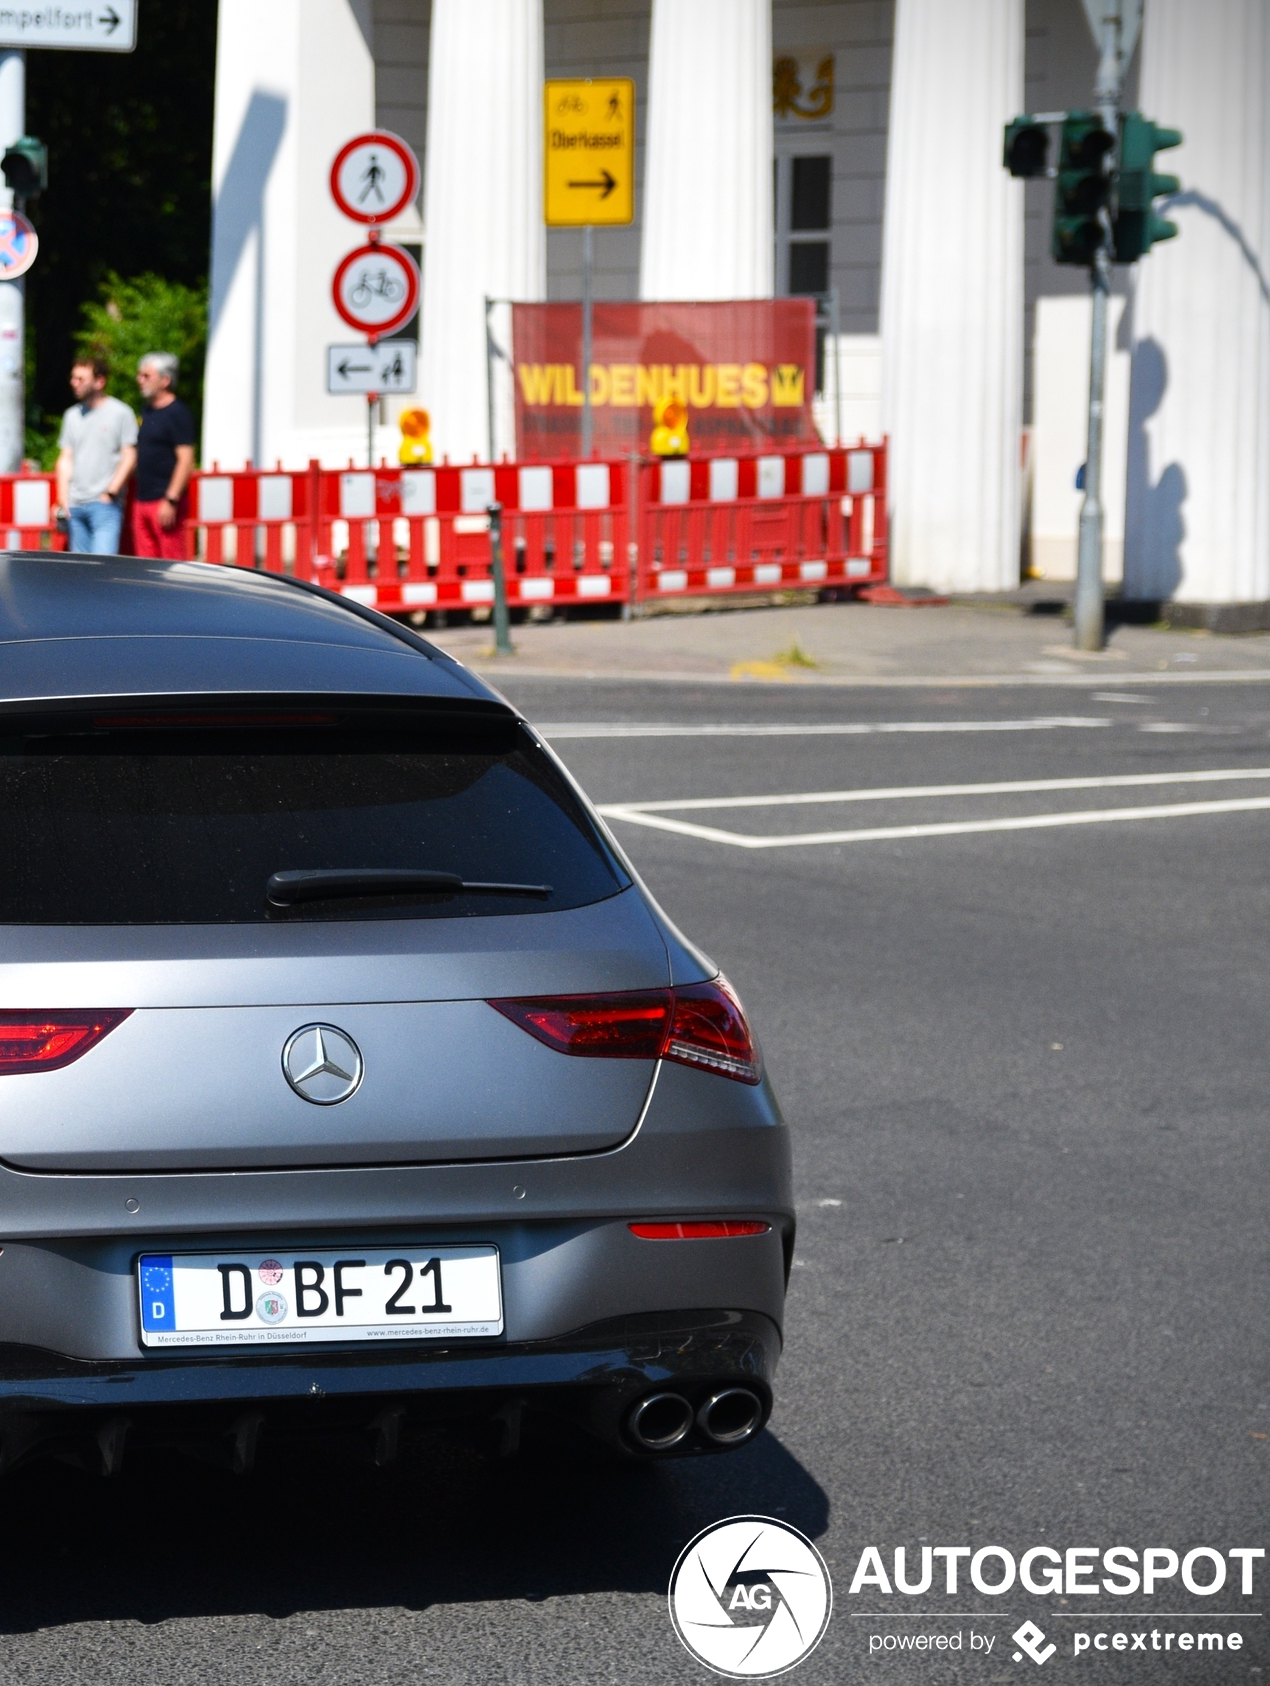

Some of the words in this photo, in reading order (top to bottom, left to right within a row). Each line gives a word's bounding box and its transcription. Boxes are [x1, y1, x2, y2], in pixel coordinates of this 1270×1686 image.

[517, 362, 769, 409] WILDENHUES
[217, 1263, 254, 1321] D
[293, 1259, 367, 1318] BF
[383, 1257, 453, 1315] 21
[152, 1302, 166, 1320] D
[157, 1334, 214, 1344] Mercedes-Benz
[215, 1332, 256, 1342] Rhein-Ruhr
[257, 1332, 266, 1341] in
[267, 1331, 308, 1341] Düsseldorf
[366, 1326, 490, 1337] www.mercedes-benz-rhein-ruhr.de
